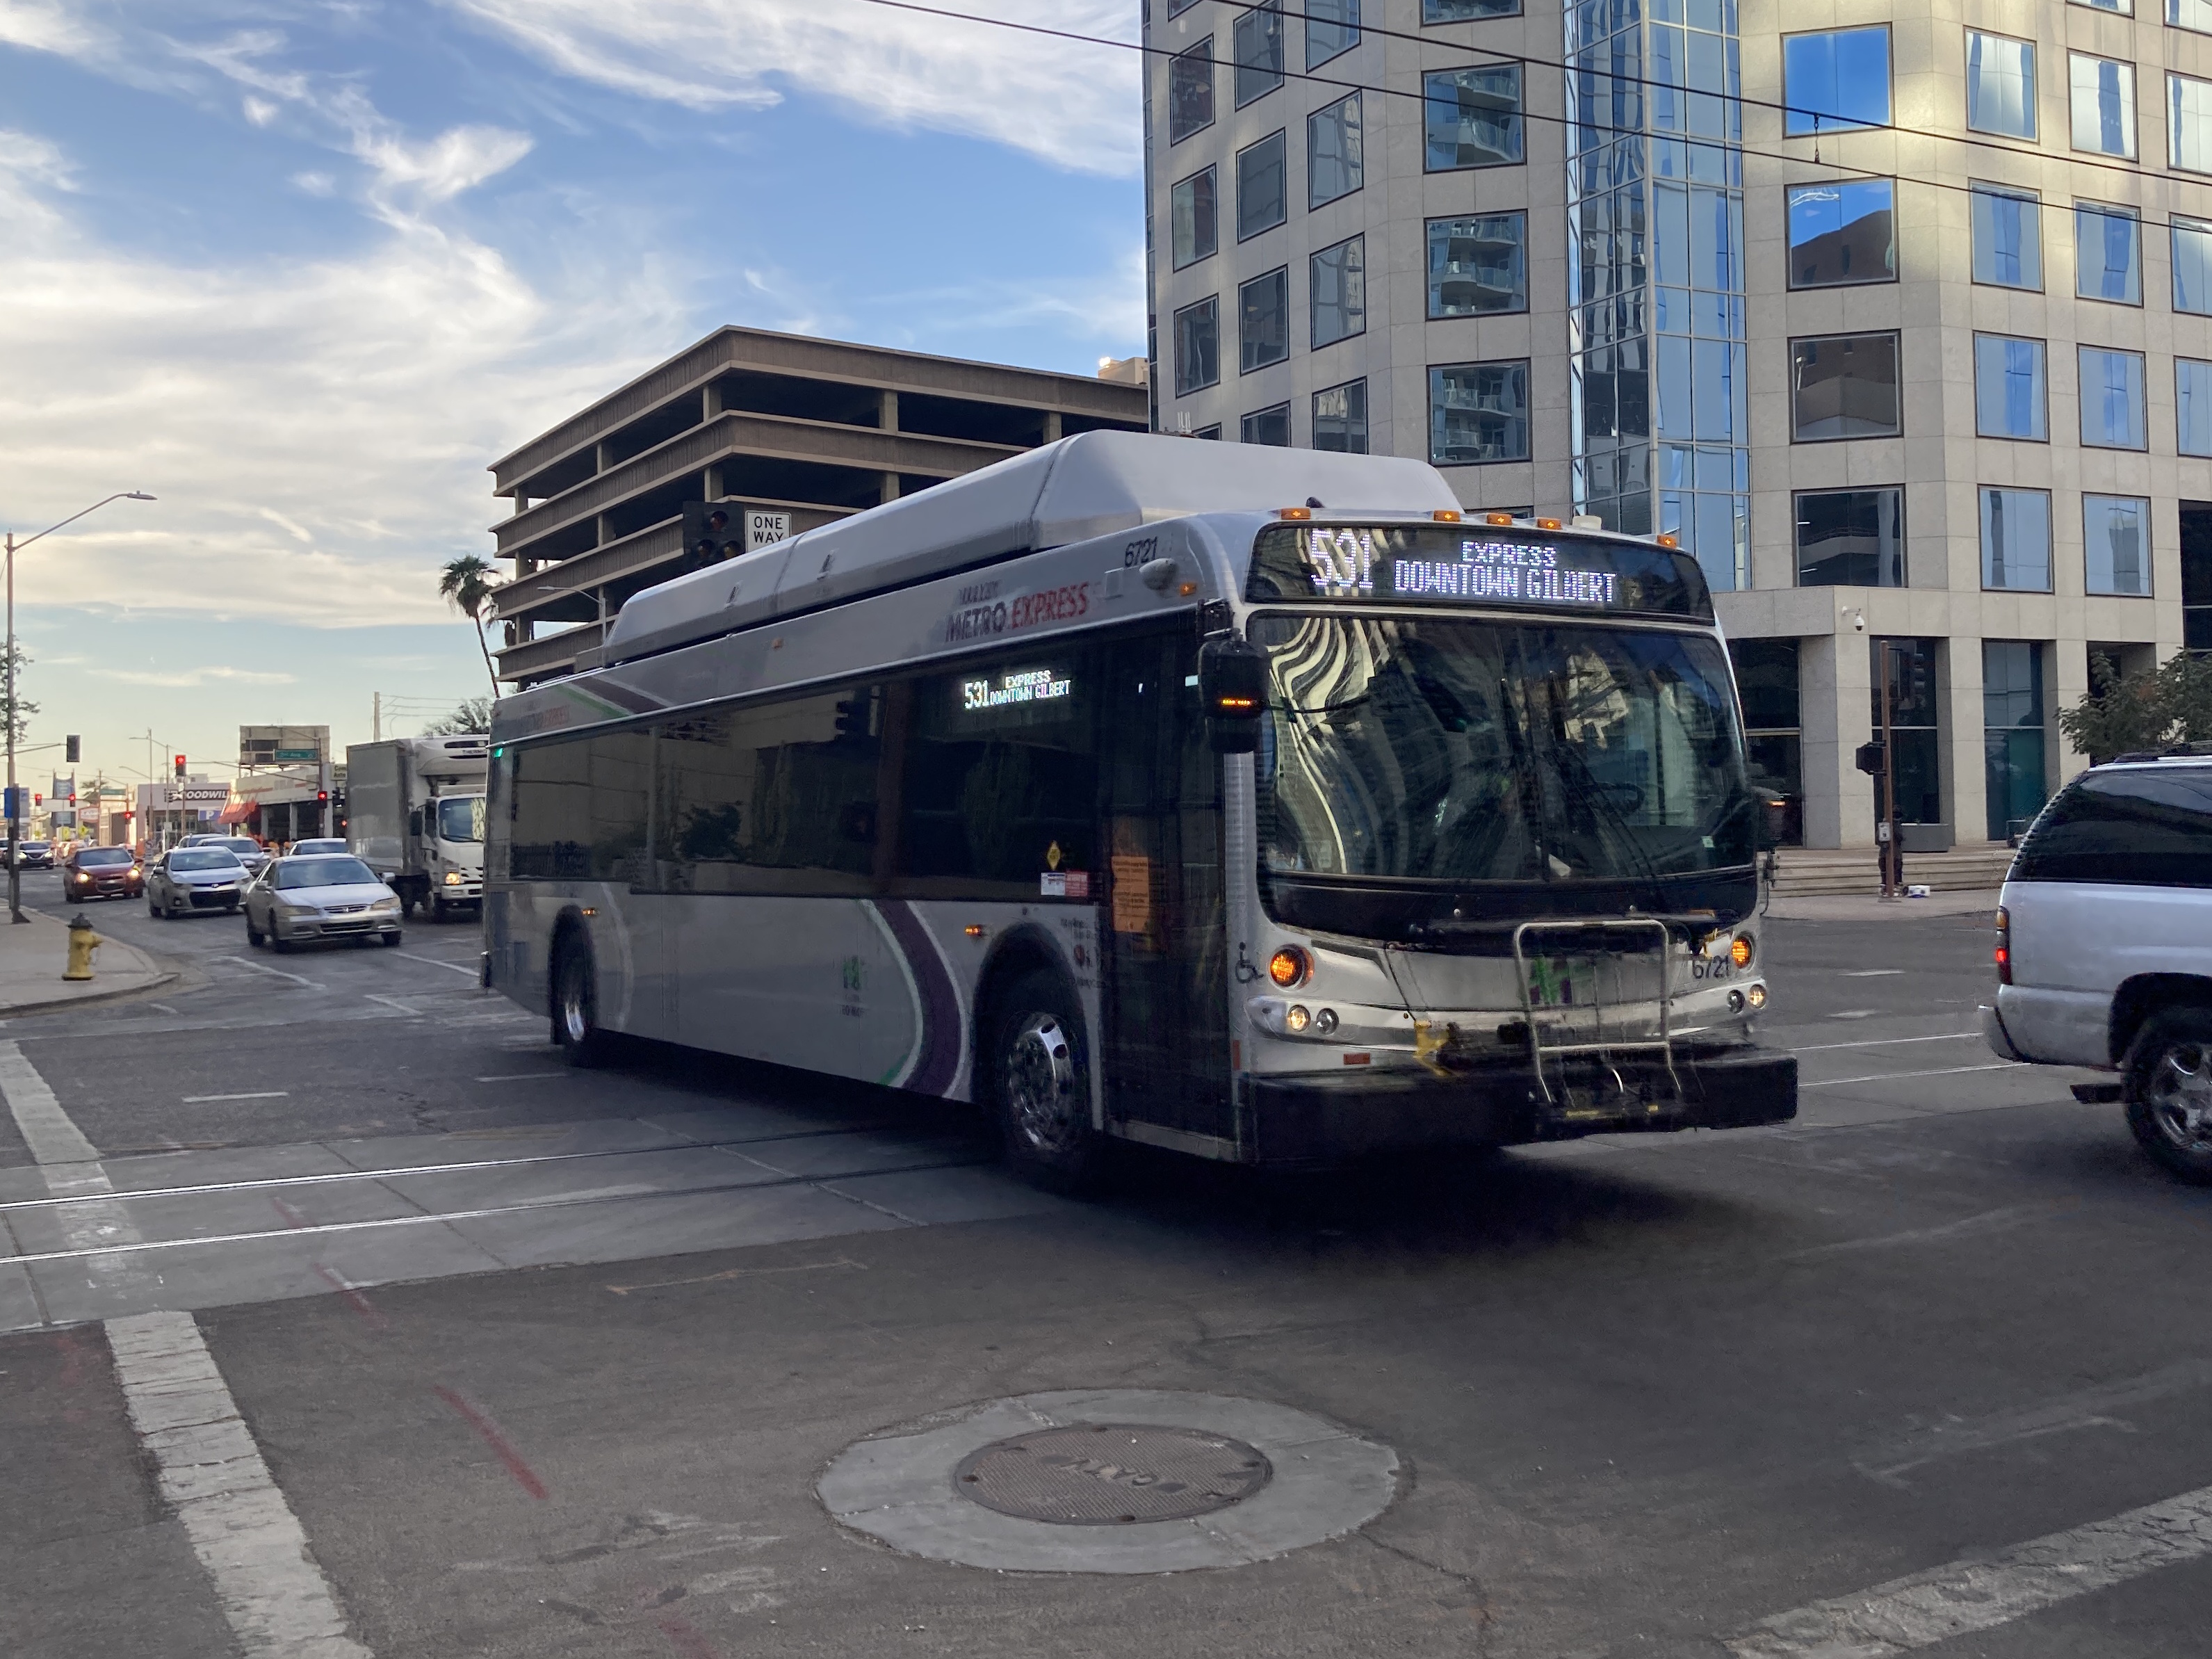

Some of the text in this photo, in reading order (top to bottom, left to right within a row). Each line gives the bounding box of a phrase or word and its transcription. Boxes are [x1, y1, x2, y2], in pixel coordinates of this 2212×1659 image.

[754, 517, 783, 529] ONE
[754, 531, 784, 543] WAY
[1124, 536, 1158, 567] 6721
[1310, 527, 1374, 589] 531
[1462, 540, 1556, 567] EXPRESS
[1394, 560, 1616, 602] DOWNTOWN GILBERT
[945, 581, 1089, 642] METRO EXPRESS
[990, 679, 1071, 706] DOWNTOWN GILBERT
[1005, 670, 1052, 688] EXPRESS
[964, 679, 990, 710] 531
[1692, 955, 1730, 979] 6721
